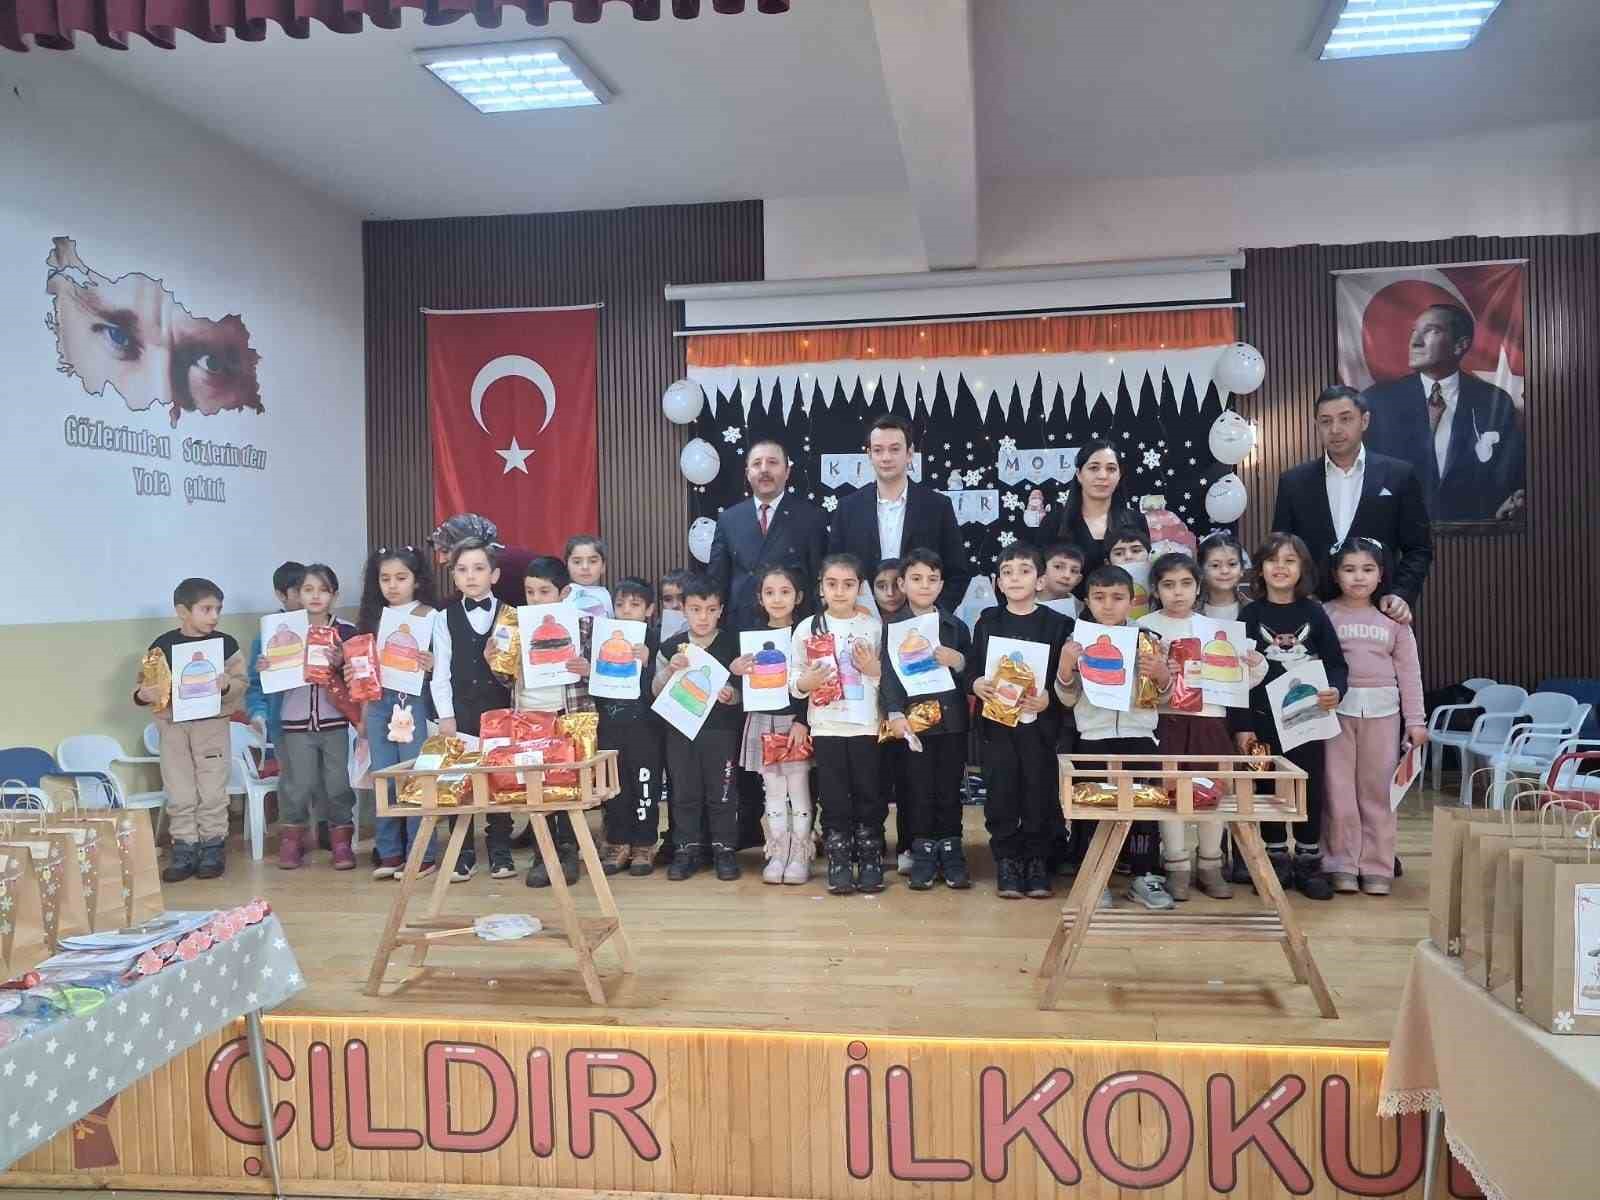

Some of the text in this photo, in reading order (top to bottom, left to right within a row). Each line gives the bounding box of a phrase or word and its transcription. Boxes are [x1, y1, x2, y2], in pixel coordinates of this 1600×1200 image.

[64, 415, 170, 458] Gözlerinden
[134, 465, 170, 495] Yola
[829, 461, 916, 475] KIA
[1337, 623, 1390, 642] ONDON
[205, 1036, 1488, 1198] ÇILDIR İLKOKU
